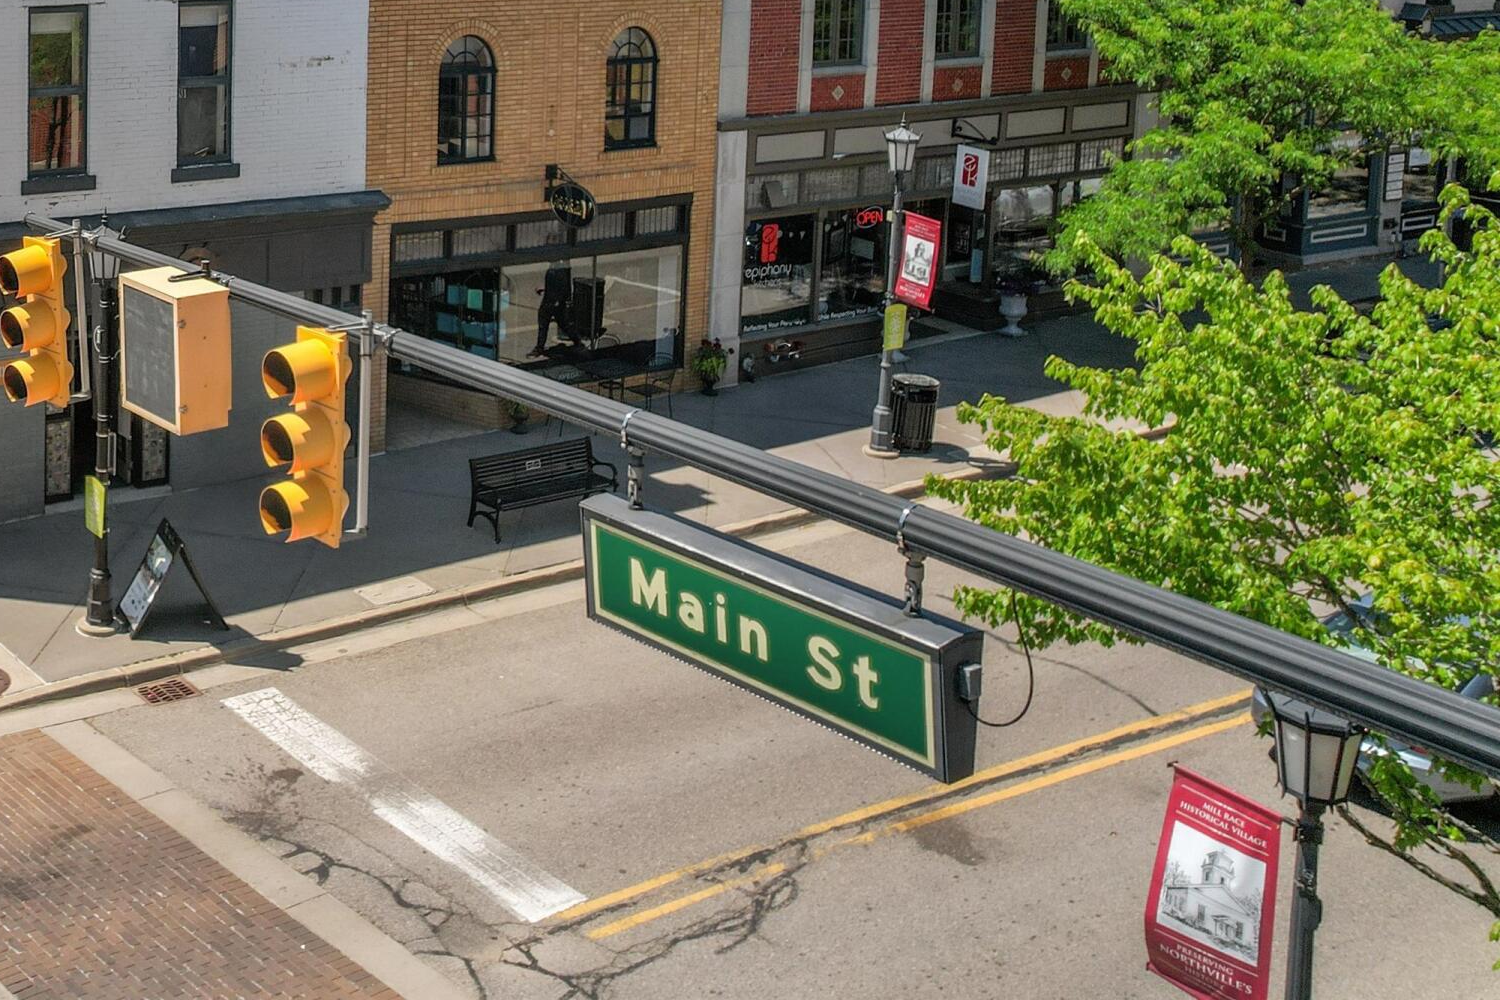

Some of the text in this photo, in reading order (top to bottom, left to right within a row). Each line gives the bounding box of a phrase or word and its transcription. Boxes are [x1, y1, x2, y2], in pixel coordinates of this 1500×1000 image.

[857, 209, 884, 225] OPEN
[629, 556, 880, 710] Main St
[1180, 800, 1268, 848] HISTORICAL VILLAGE
[1203, 802, 1246, 828] MILL RACE
[1159, 943, 1253, 995] NORTHVILLE'S
[1176, 944, 1234, 976] PRESERVING
